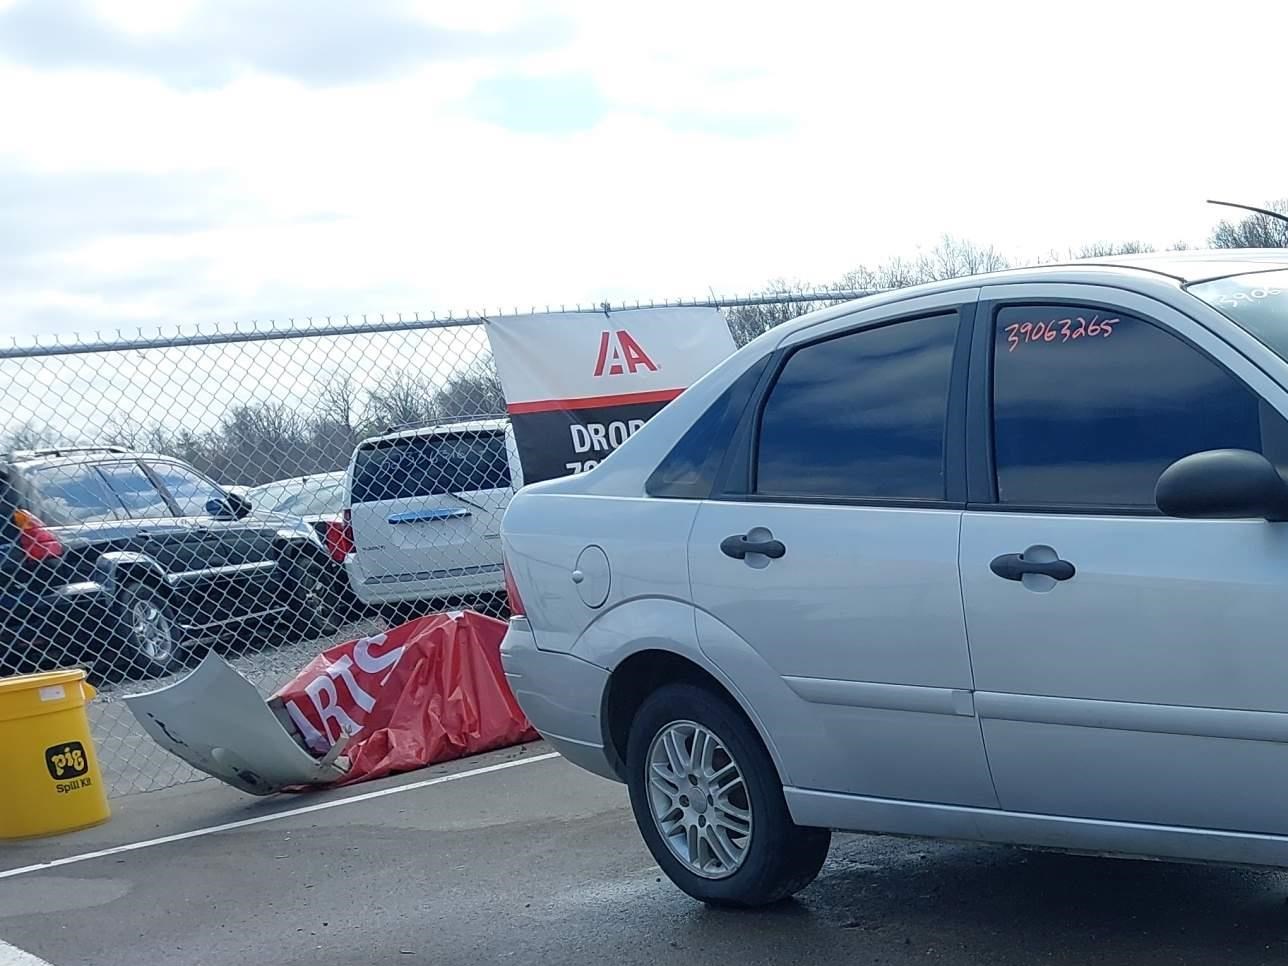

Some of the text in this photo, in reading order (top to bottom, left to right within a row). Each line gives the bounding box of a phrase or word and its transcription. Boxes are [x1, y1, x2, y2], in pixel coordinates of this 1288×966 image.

[1004, 315, 1120, 352] 39063265
[594, 330, 658, 377] IAA
[51, 746, 85, 776] pig
[56, 780, 80, 793] Spill
